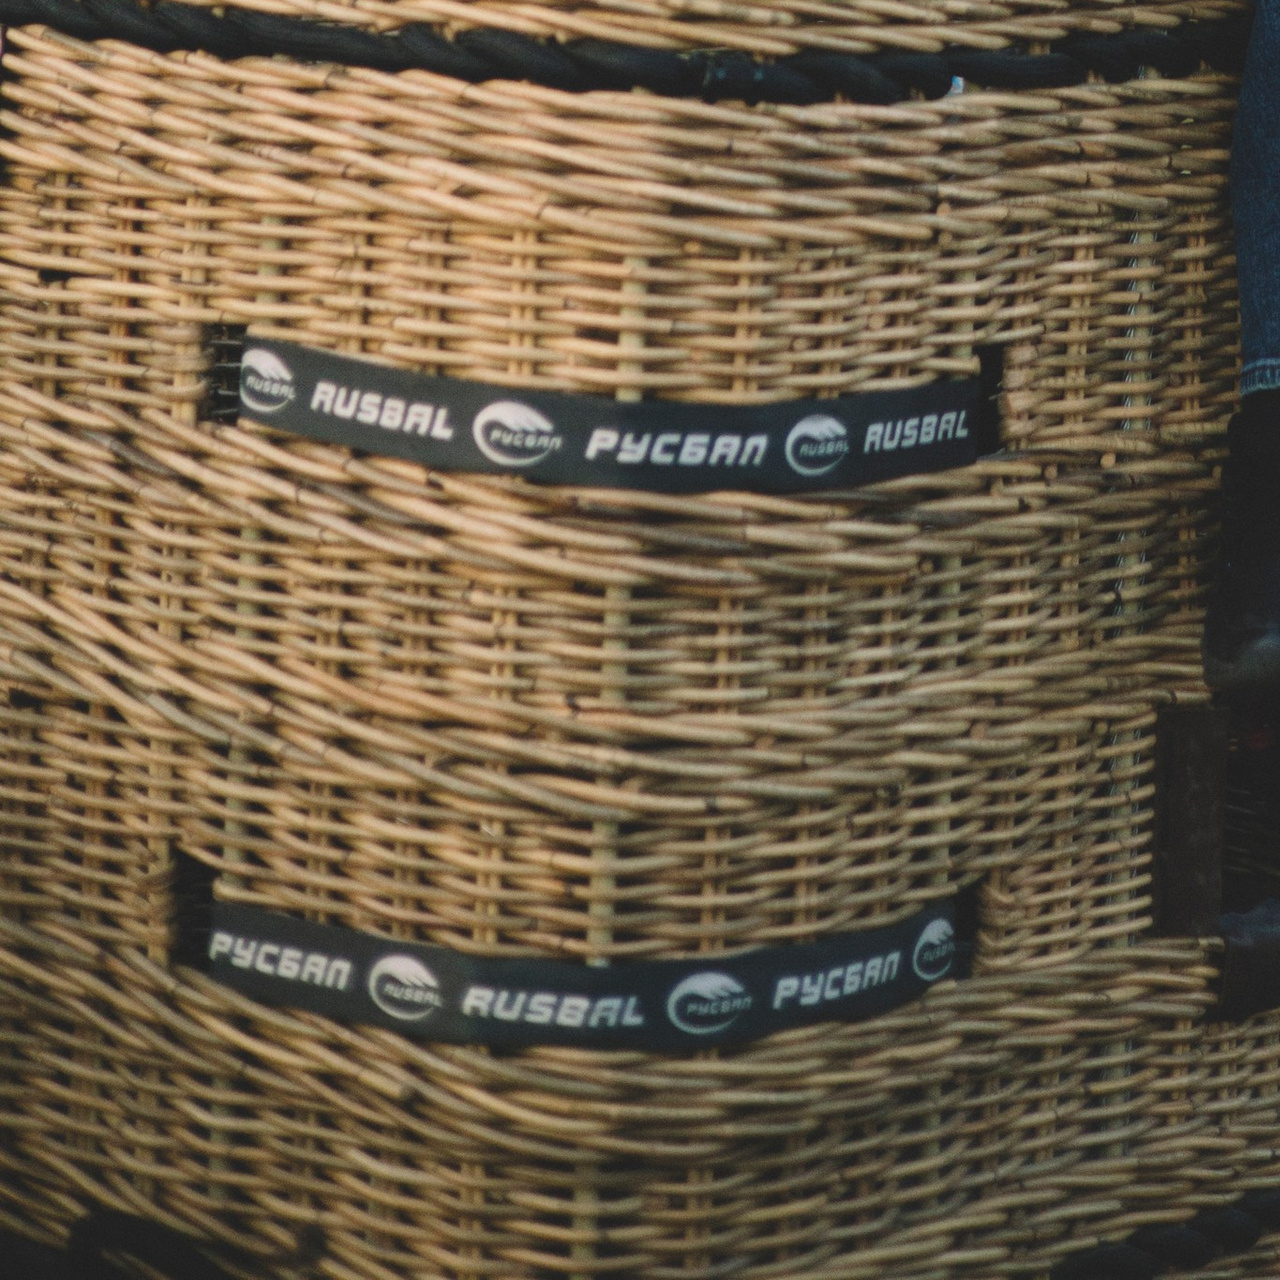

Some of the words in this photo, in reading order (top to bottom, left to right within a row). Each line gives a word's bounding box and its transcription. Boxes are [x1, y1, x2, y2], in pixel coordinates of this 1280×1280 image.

[246, 375, 297, 400] RUSBAL
[310, 380, 455, 441] RUSBAL
[863, 409, 970, 454] RUSBAL
[584, 428, 769, 467] РУСБАЛ
[800, 440, 850, 458] RUSBAL
[208, 931, 353, 991] РУСБАЛ
[772, 949, 901, 1010] РУСБАЛ
[461, 985, 645, 1029] RUSBAL
